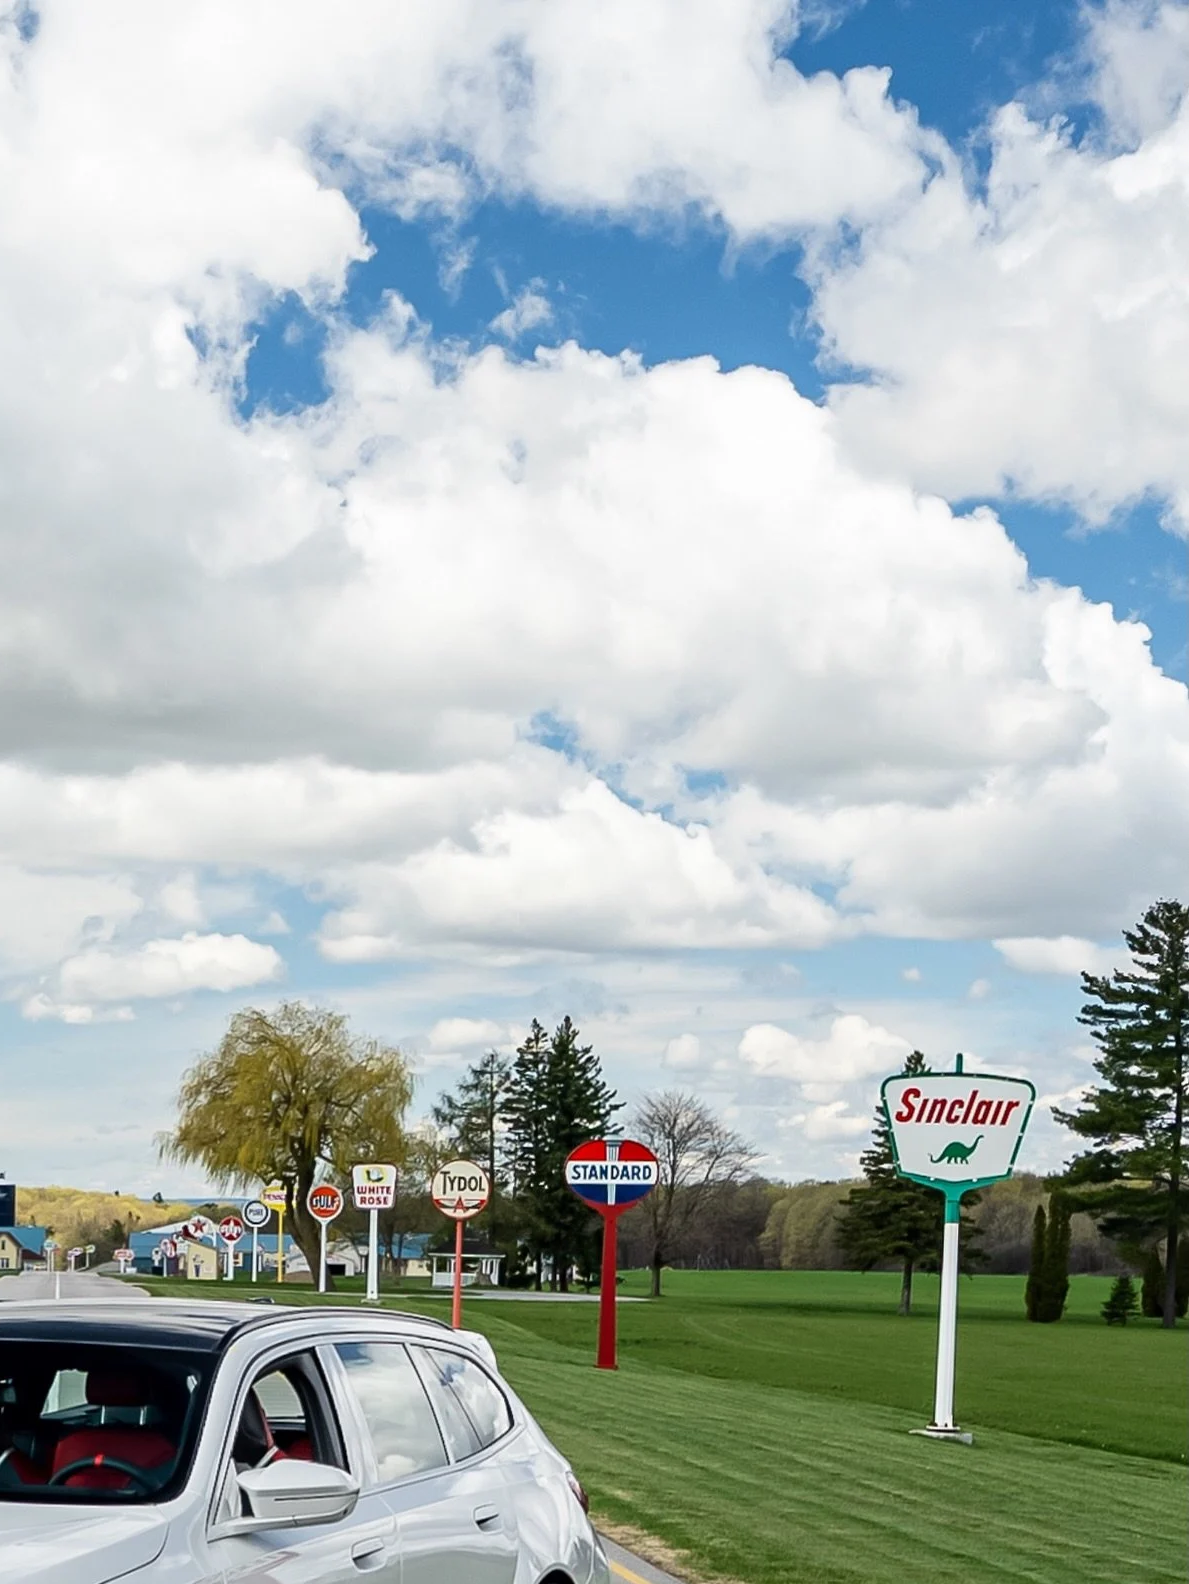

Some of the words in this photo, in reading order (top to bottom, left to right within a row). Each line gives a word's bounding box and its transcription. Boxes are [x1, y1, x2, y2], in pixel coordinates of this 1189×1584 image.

[895, 1088, 1020, 1126] Sinclair
[571, 1165, 652, 1180] STANDARD
[356, 1185, 392, 1195] WHITE
[440, 1171, 486, 1195] TYDOL
[312, 1195, 340, 1210] GULF
[359, 1196, 388, 1205] ROSE
